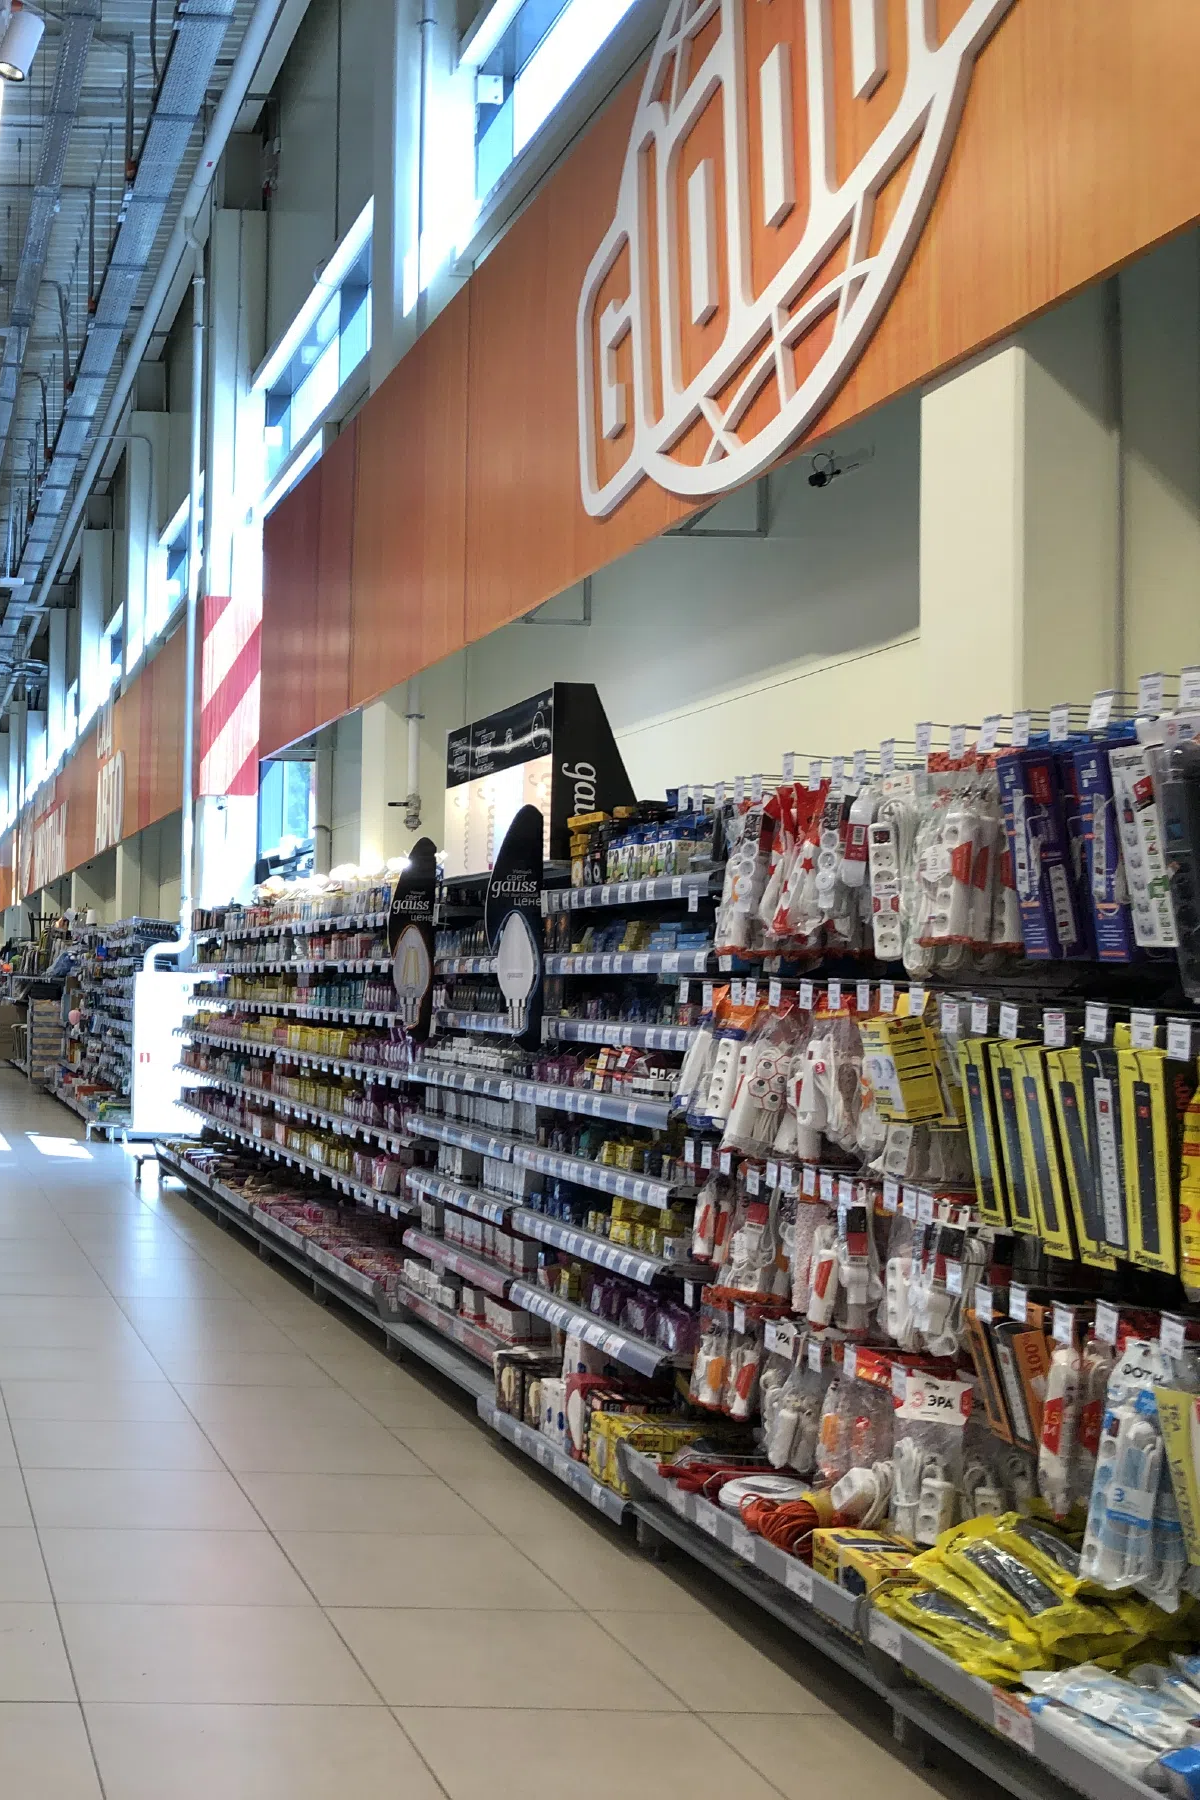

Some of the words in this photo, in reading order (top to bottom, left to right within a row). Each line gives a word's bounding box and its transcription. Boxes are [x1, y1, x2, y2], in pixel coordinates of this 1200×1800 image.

[562, 761, 597, 817] gau
[95, 749, 125, 855] АВТО
[506, 874, 528, 882] свет
[491, 880, 537, 898] gauss
[392, 900, 430, 914] gauss
[513, 898, 541, 907] цене
[410, 914, 433, 922] цене
